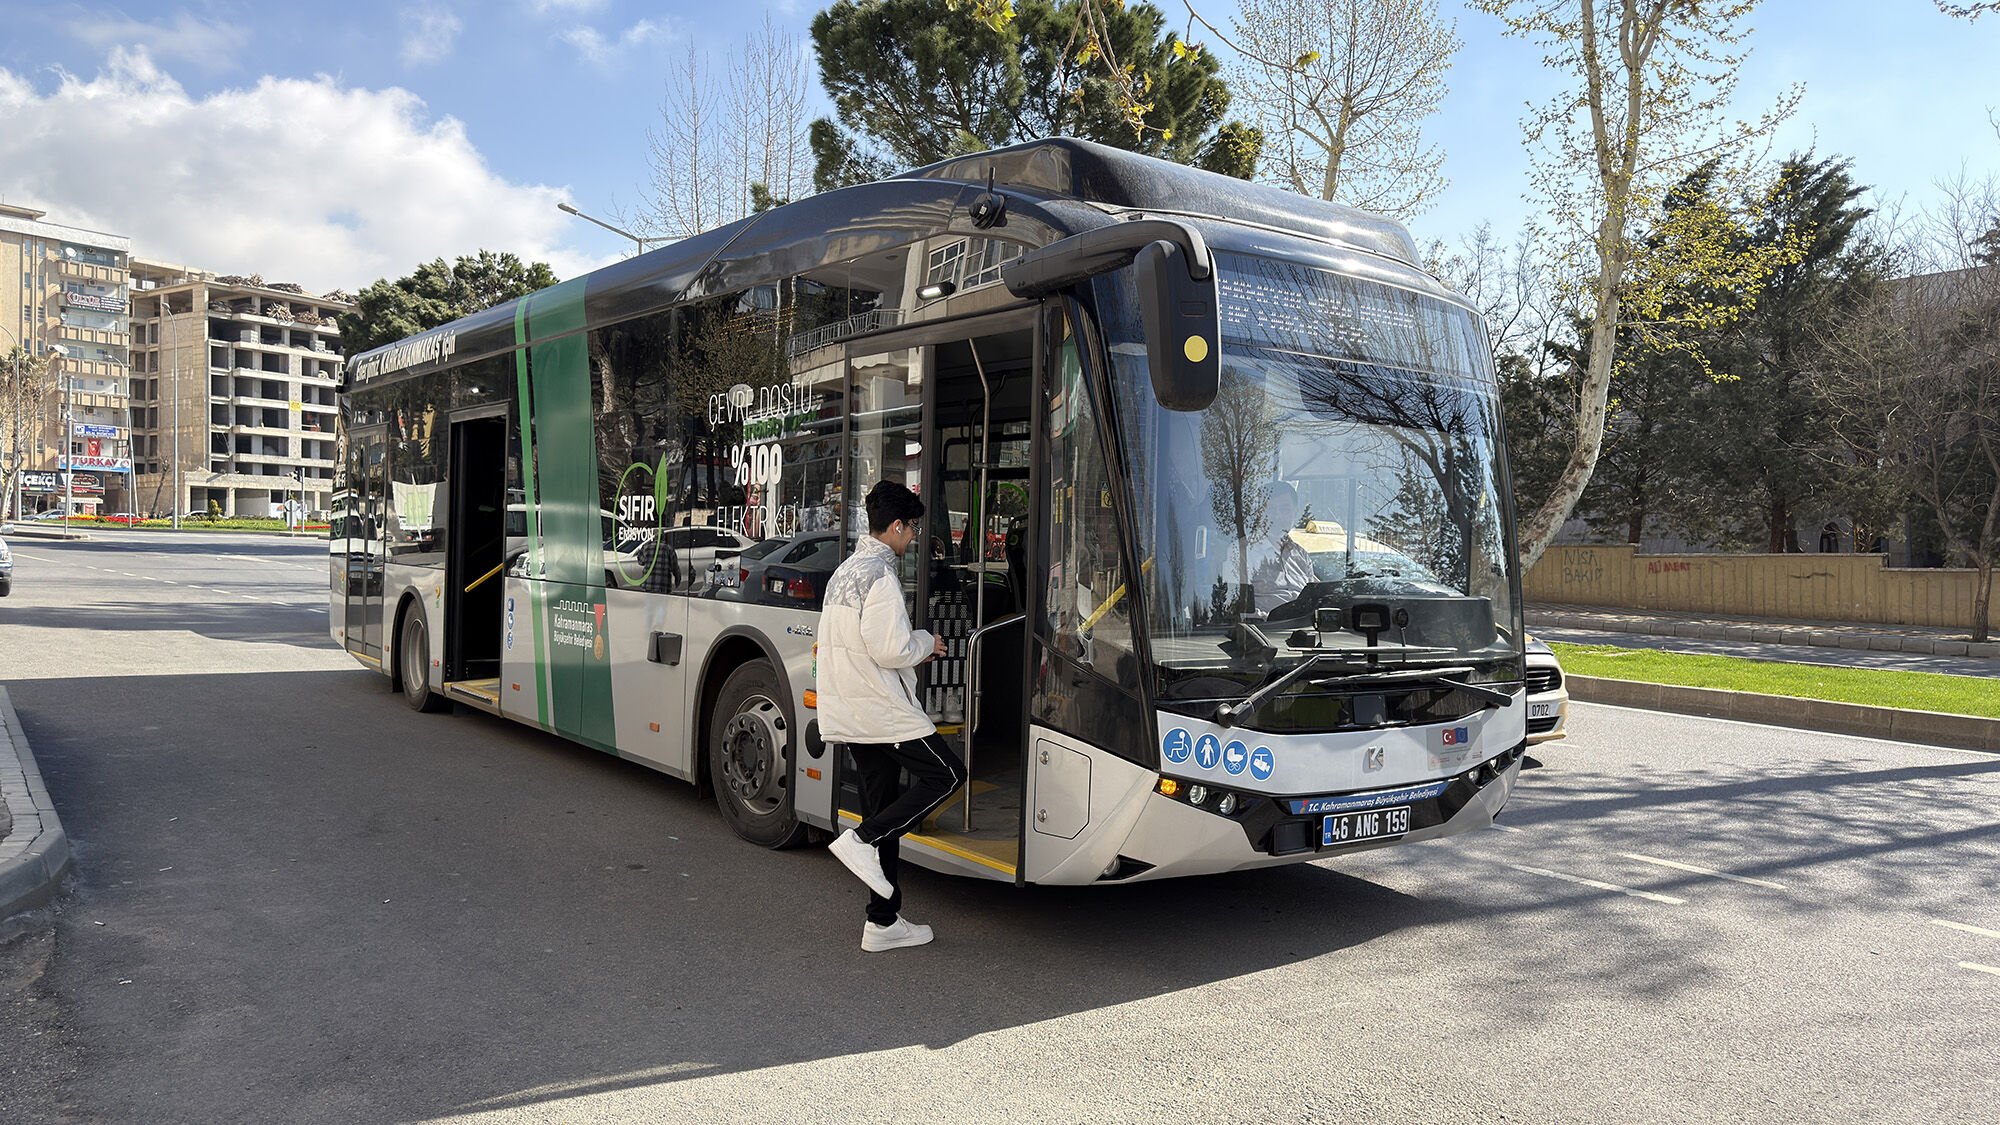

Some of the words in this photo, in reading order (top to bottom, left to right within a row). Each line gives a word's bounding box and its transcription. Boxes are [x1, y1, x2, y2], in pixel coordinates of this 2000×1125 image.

[381, 333, 442, 375] KAHRAMANMARAŞ
[442, 329, 456, 362] için
[709, 388, 754, 432] ÇEVRE
[759, 380, 812, 419] DOSTU
[731, 443, 783, 486] %100
[619, 495, 655, 521] SIFIR
[716, 496, 797, 540] ELEKTRKLİ
[1663, 561, 1691, 573] MERT
[553, 613, 593, 635] Kahramanmaraş
[1531, 704, 1549, 717] 0702
[1308, 803, 1320, 812] T.C.
[1320, 799, 1375, 811] Kahramanmaraş
[1375, 793, 1408, 806] Büyükşehir
[1408, 787, 1440, 800] Belediyesi
[1332, 816, 1349, 840] 46
[1355, 813, 1379, 837] ANG
[1386, 810, 1408, 833] 159
